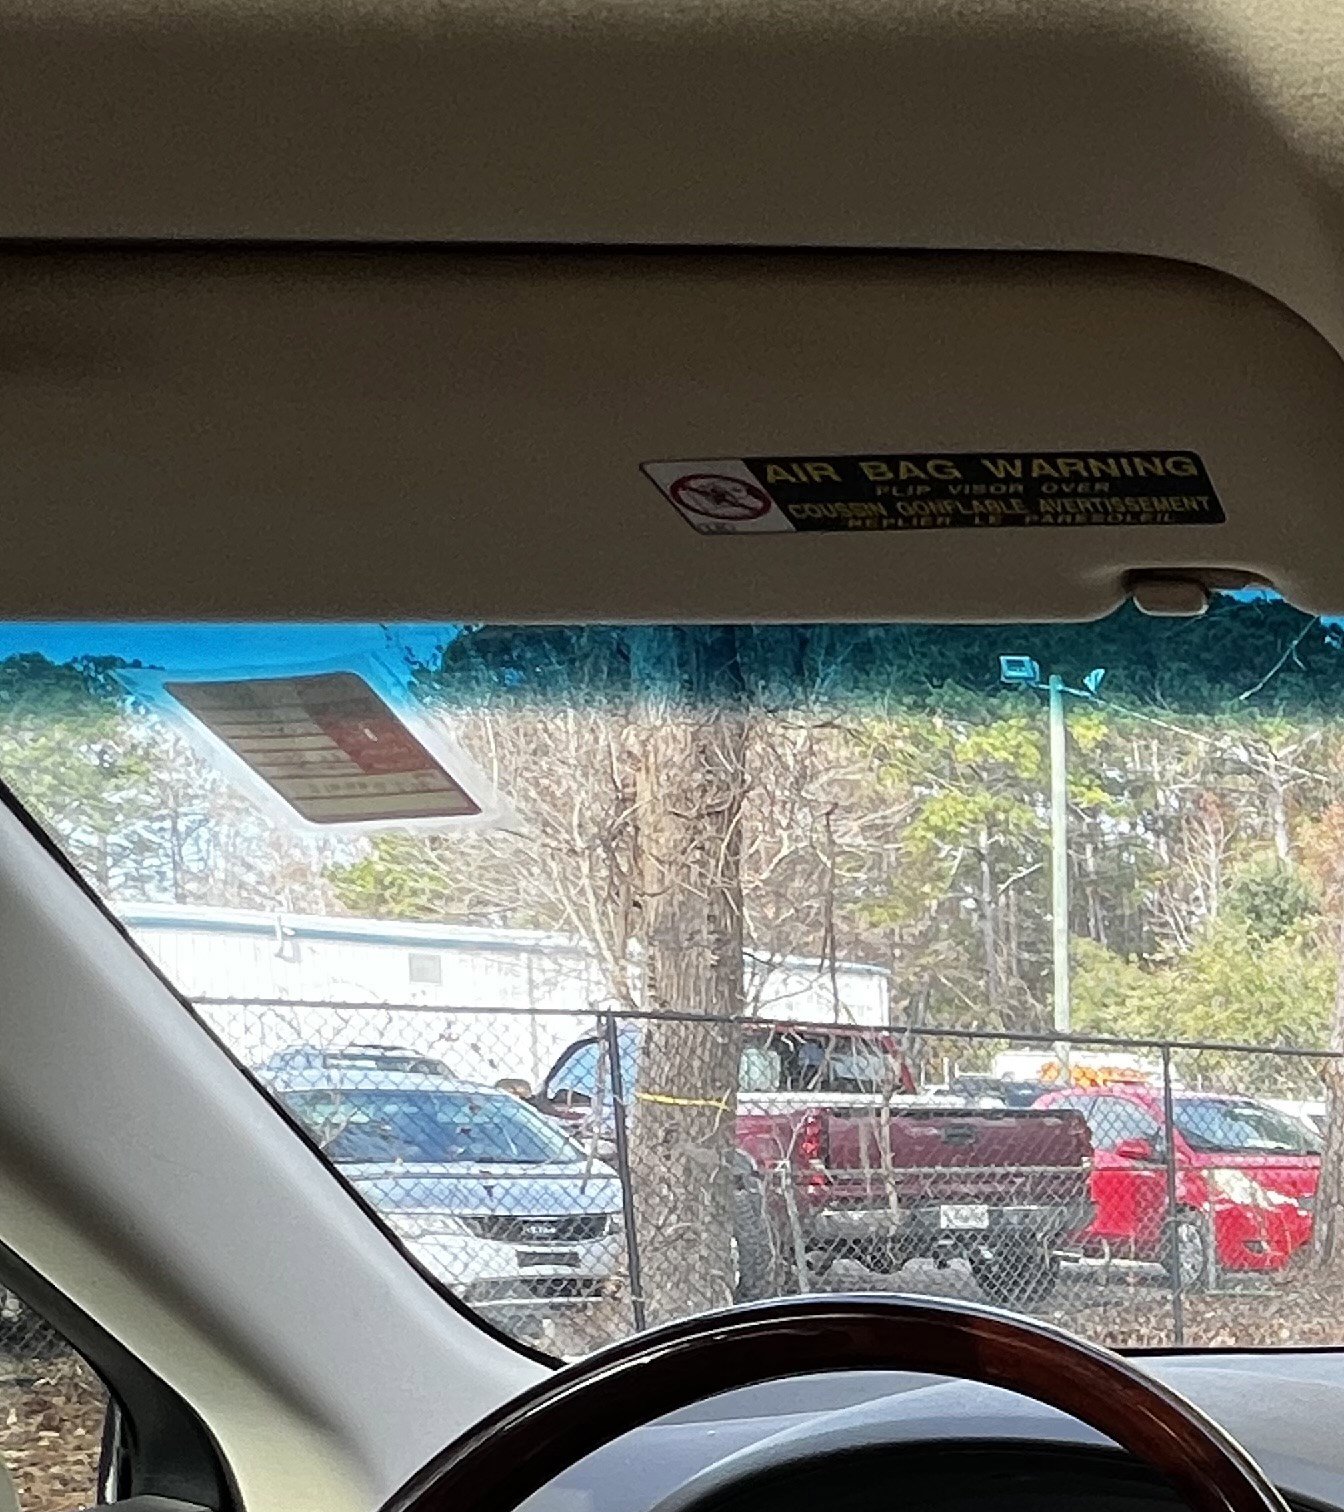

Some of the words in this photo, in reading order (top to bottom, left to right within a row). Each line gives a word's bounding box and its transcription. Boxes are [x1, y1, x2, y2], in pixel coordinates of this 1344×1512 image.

[766, 462, 843, 484] AIR
[858, 459, 962, 481] BAG
[981, 456, 1198, 478] WARNING
[788, 501, 888, 519] COUSSIN
